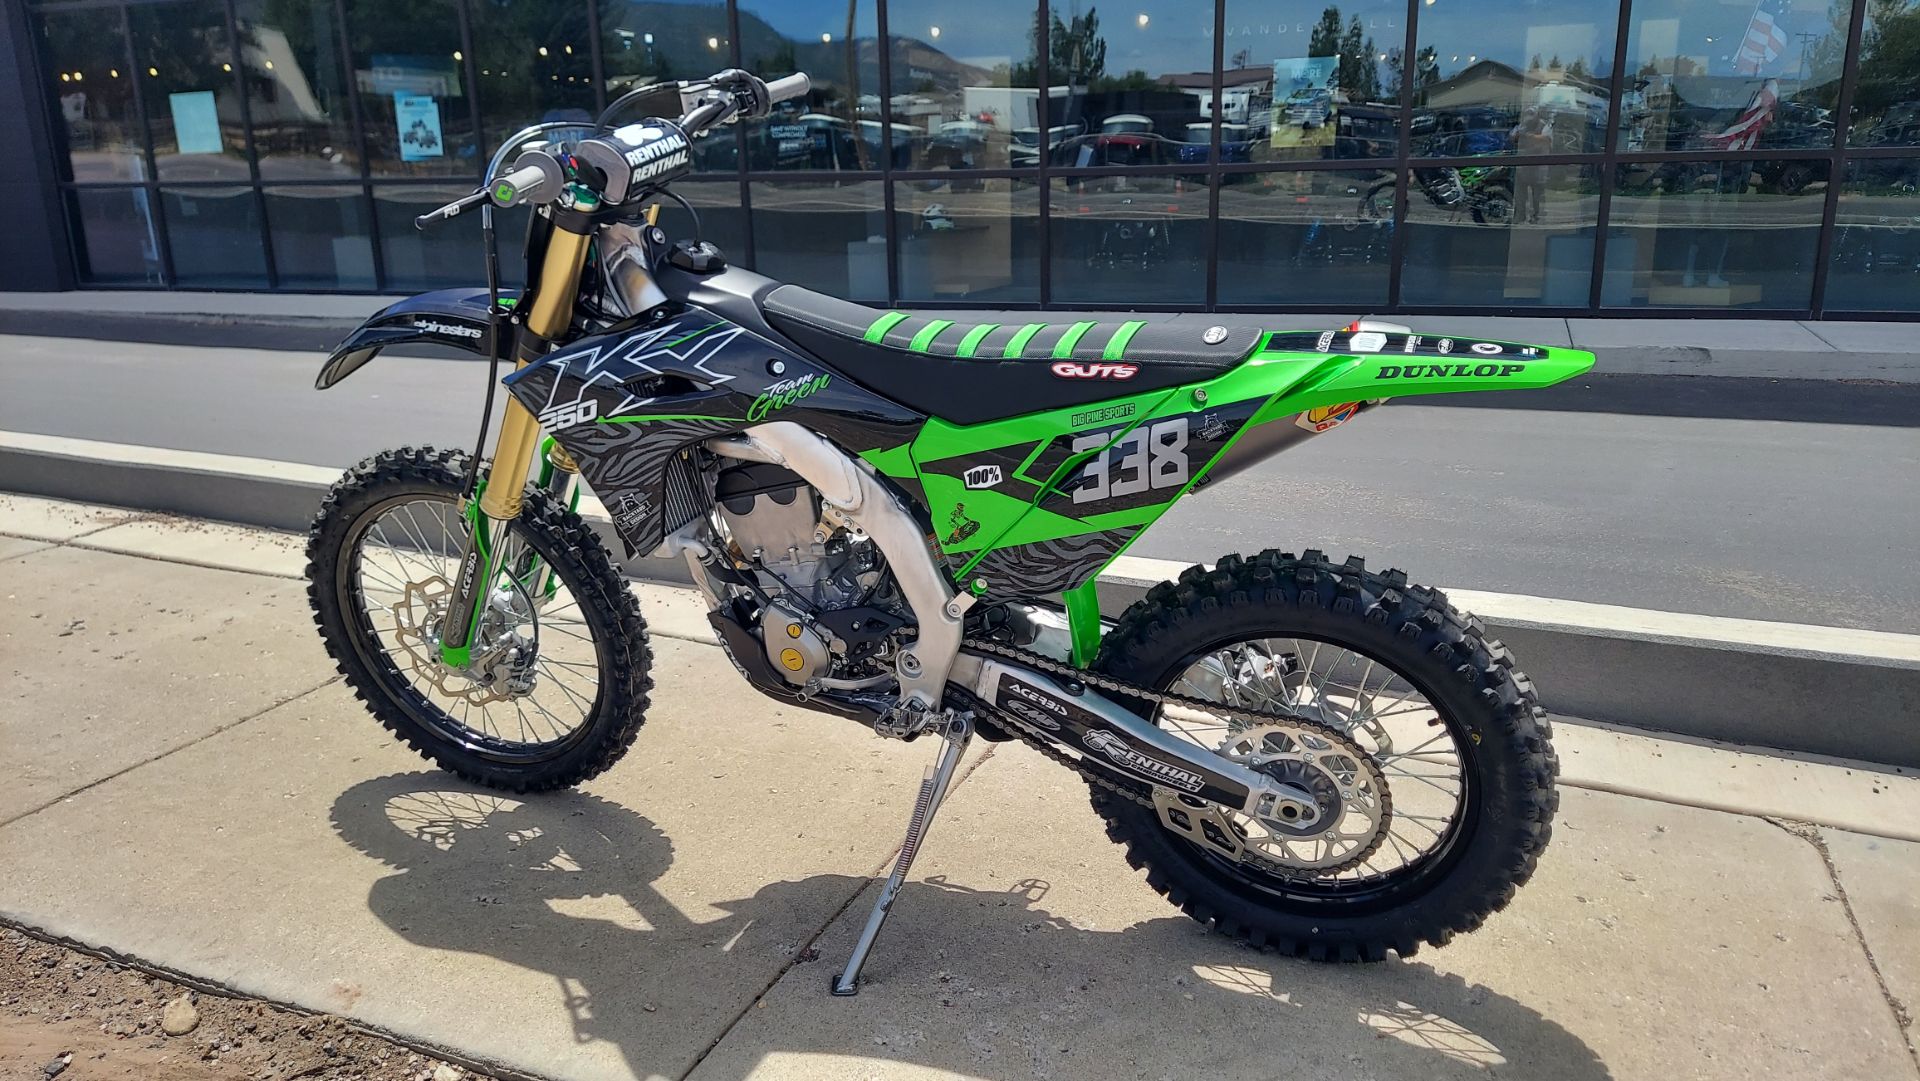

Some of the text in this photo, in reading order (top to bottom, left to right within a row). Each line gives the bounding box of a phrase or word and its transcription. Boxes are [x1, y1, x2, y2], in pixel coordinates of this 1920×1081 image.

[1225, 18, 1396, 37] VANDELL
[624, 134, 687, 168] RENTHAL
[631, 149, 689, 185] RENTHAL
[413, 320, 483, 339] alpinestars
[1050, 361, 1139, 380] GUTS
[1374, 364, 1526, 380] DUNLOP
[746, 373, 833, 422] Green
[763, 373, 815, 398] Team
[538, 399, 598, 433] 250
[1071, 402, 1136, 428] BIG PINE SPORTS
[1072, 417, 1189, 505] 338
[966, 466, 1000, 486] 100%
